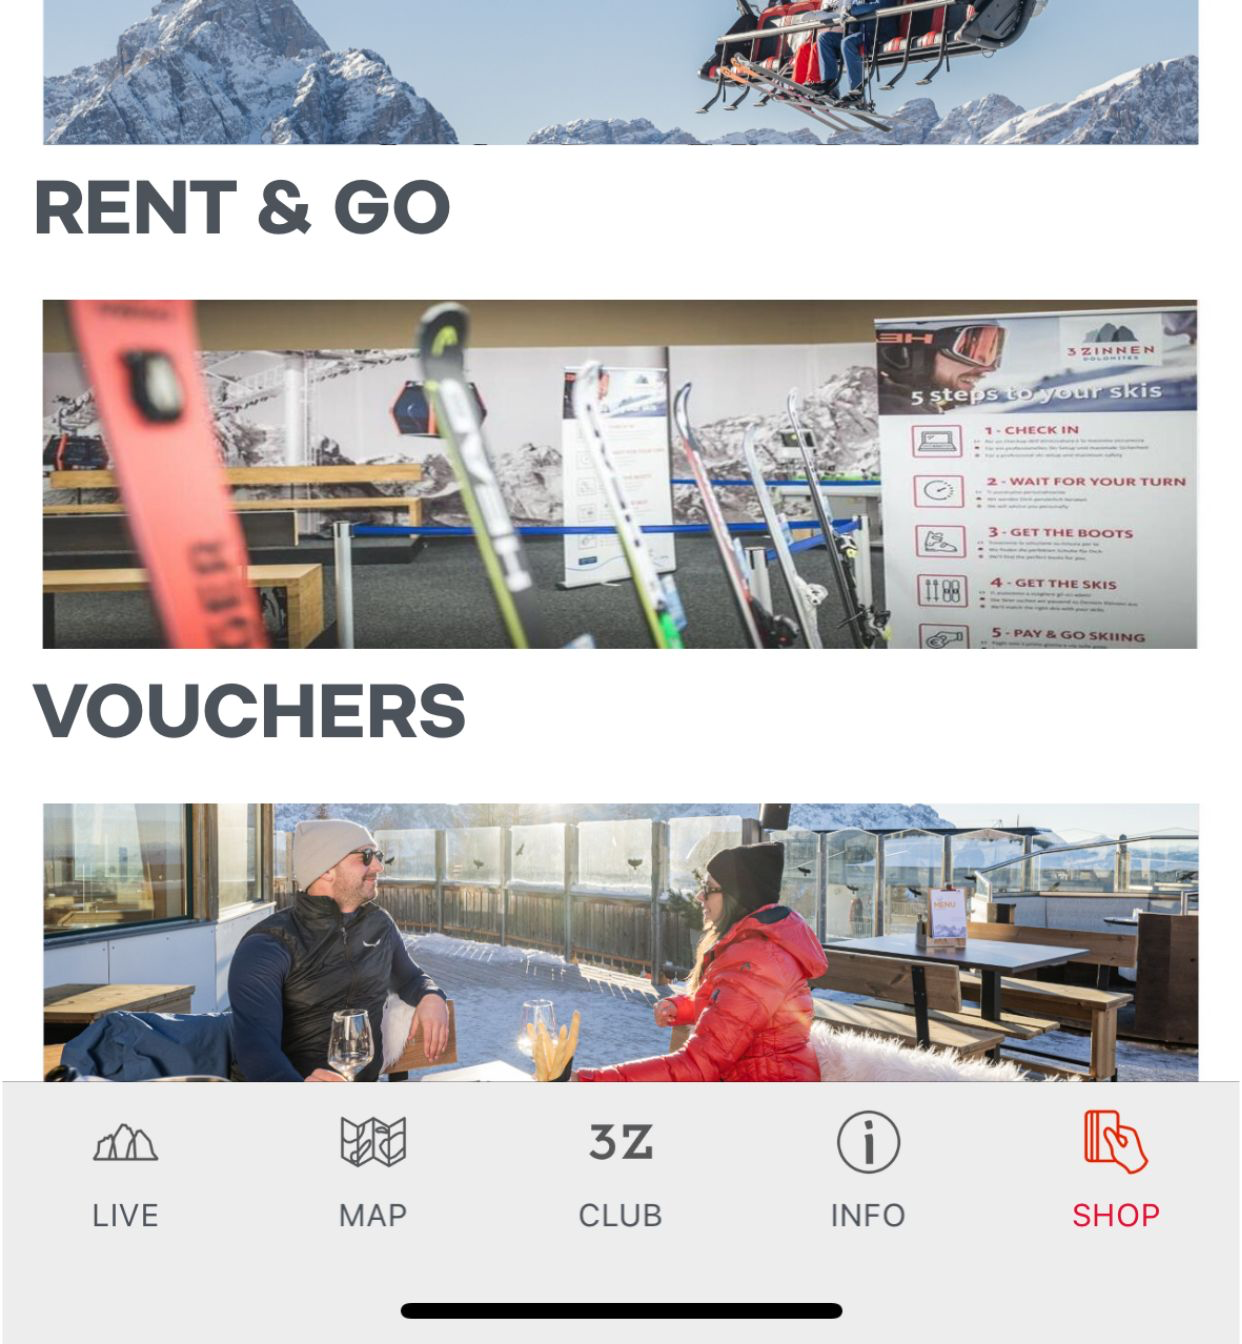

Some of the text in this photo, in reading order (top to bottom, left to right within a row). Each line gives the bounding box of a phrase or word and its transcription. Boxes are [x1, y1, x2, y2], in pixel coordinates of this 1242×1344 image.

[36, 179, 451, 235] RENT & GO
[1067, 345, 1154, 356] 3 ZINNEN
[911, 383, 1162, 406] 5 steps to your skis
[985, 426, 992, 435] 1
[1005, 426, 1058, 435] CHECK
[1062, 426, 1079, 434] IN
[987, 477, 998, 486] 2
[1009, 477, 1050, 486] WAIT
[1054, 477, 1085, 486] FOR
[1090, 477, 1136, 486] YOUR
[1139, 477, 1186, 486] TURN
[988, 527, 998, 538] 3
[1011, 528, 1040, 537] GET
[1043, 528, 1073, 538] THE
[1078, 528, 1134, 539] BOOTS
[990, 577, 1003, 588] 4
[1015, 579, 1045, 588] GET
[1048, 579, 1078, 589] THE
[1082, 580, 1117, 590] SKIS
[991, 627, 1002, 638] 5
[1013, 629, 1043, 639] PAY
[1046, 629, 1057, 639] &
[1060, 630, 1086, 640] GO
[1089, 631, 1146, 643] SKIING
[32, 682, 466, 739] VOUCHERS
[589, 1123, 654, 1161] 3Z
[93, 1203, 158, 1227] LIVE
[340, 1203, 407, 1227] MAP
[579, 1202, 662, 1228] CLUB
[832, 1202, 905, 1228] INFO
[1073, 1202, 1160, 1228] SHOP
